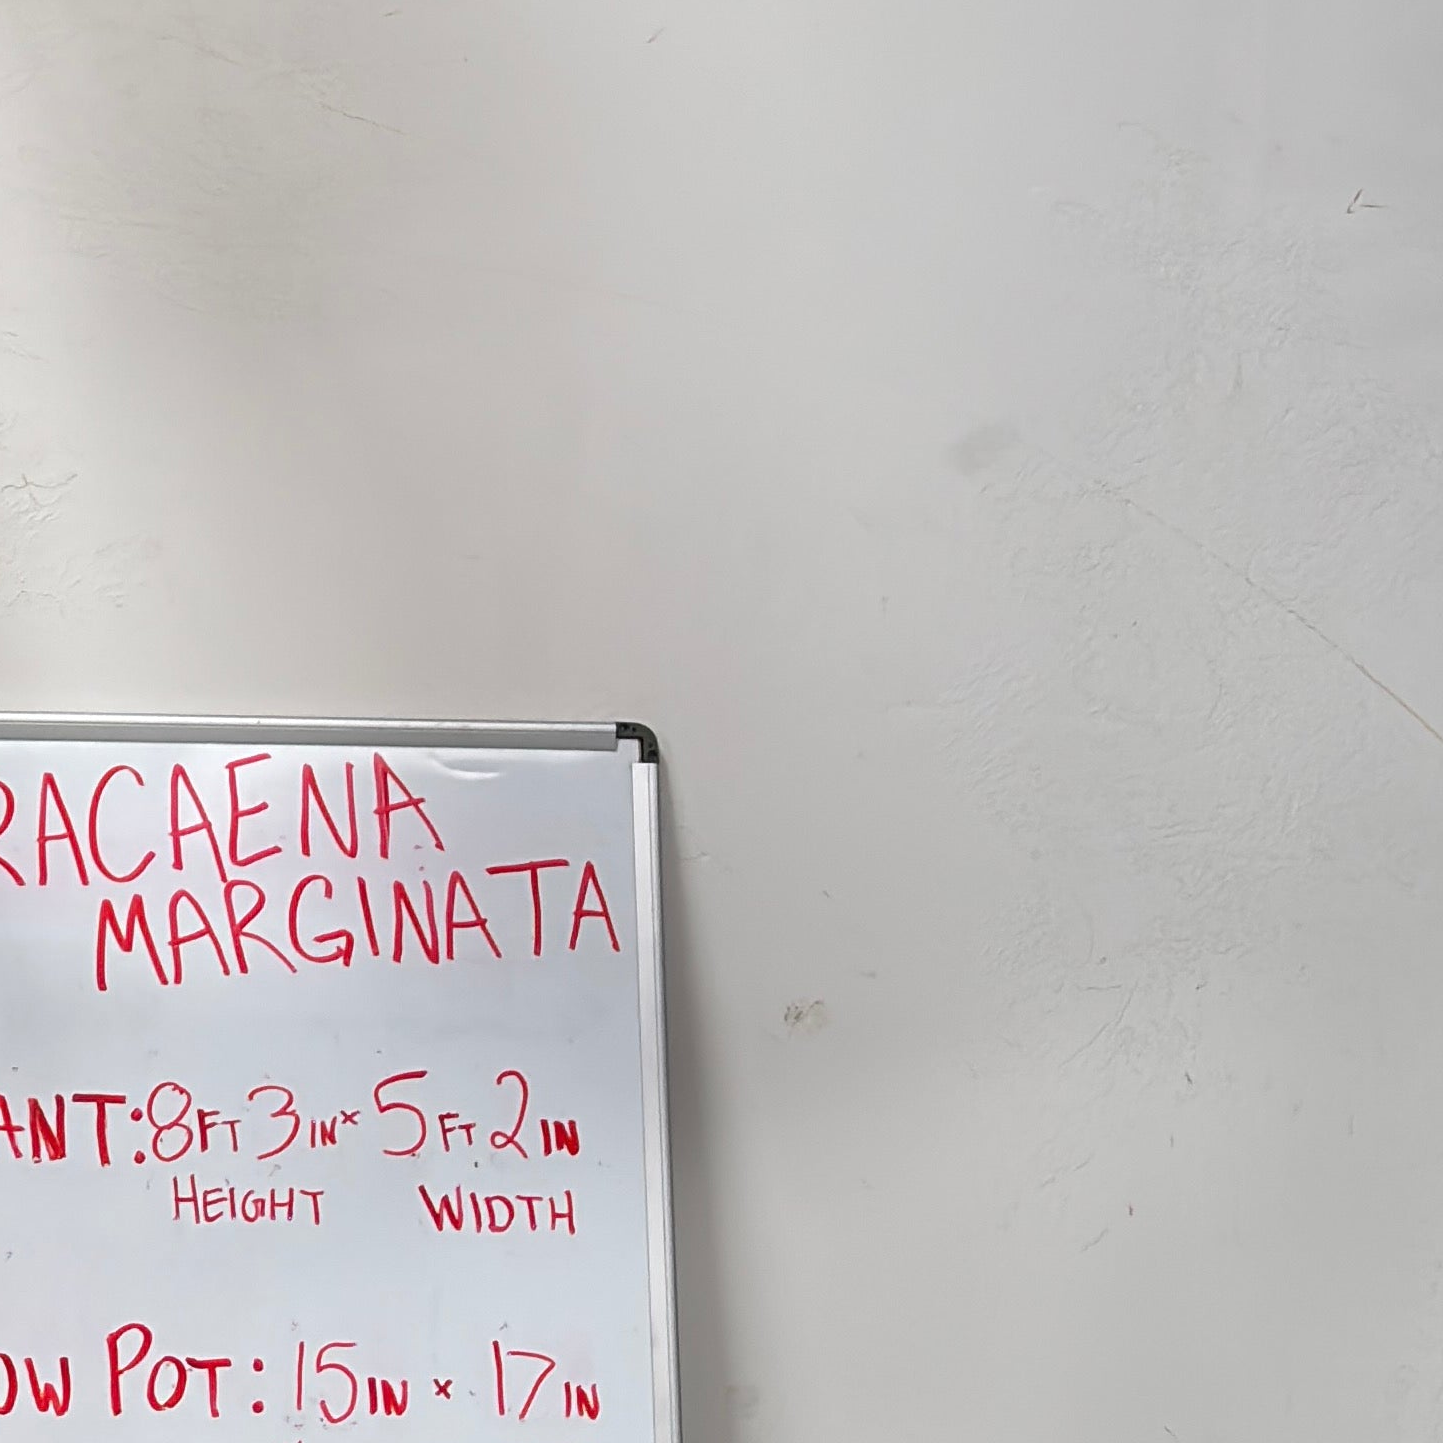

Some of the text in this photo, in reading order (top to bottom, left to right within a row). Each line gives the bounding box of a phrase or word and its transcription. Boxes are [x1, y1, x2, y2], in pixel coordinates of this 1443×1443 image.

[94, 858, 622, 993] MARGINATA
[171, 1175, 577, 1236] HEIGHT WIDTH
[104, 1321, 265, 1420] POT:
